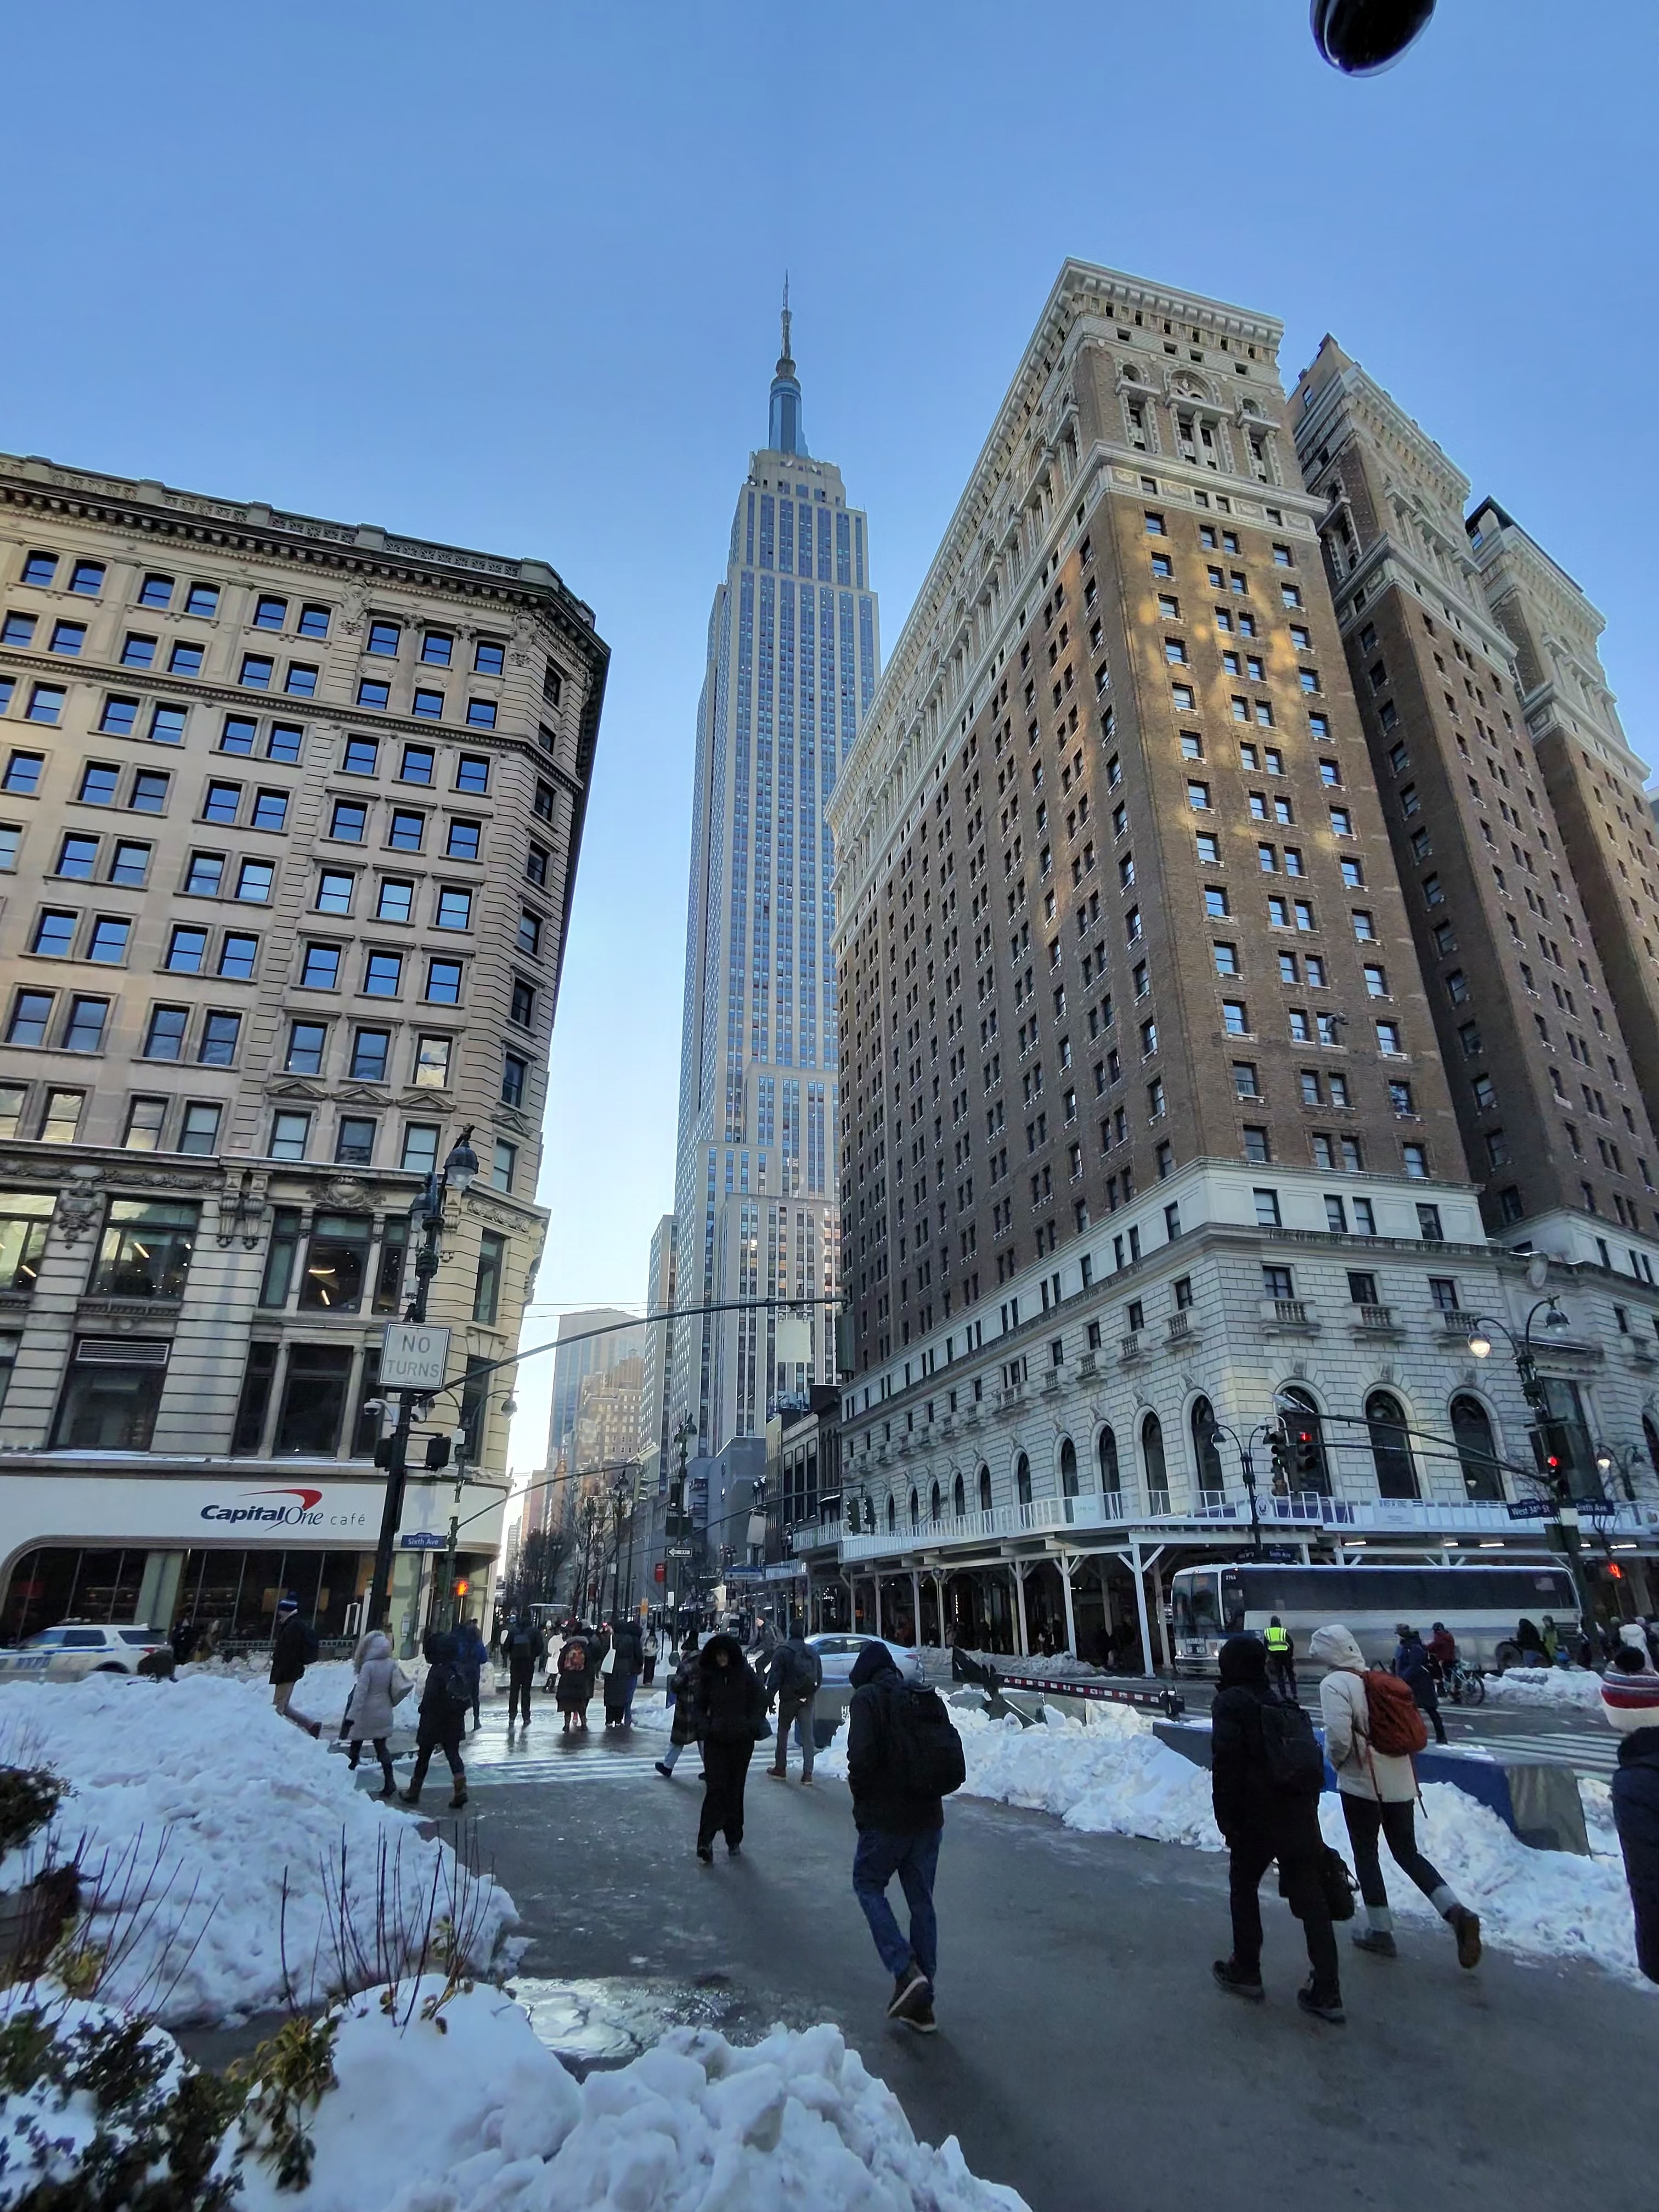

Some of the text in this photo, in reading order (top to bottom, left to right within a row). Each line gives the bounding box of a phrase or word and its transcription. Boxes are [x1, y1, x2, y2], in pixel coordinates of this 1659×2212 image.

[402, 1335, 430, 1353] NO
[387, 1360, 439, 1378] TURNS
[1511, 1504, 1550, 1516] West 34th St
[1576, 1502, 1608, 1512] Sixth Ave
[330, 1513, 365, 1526] café
